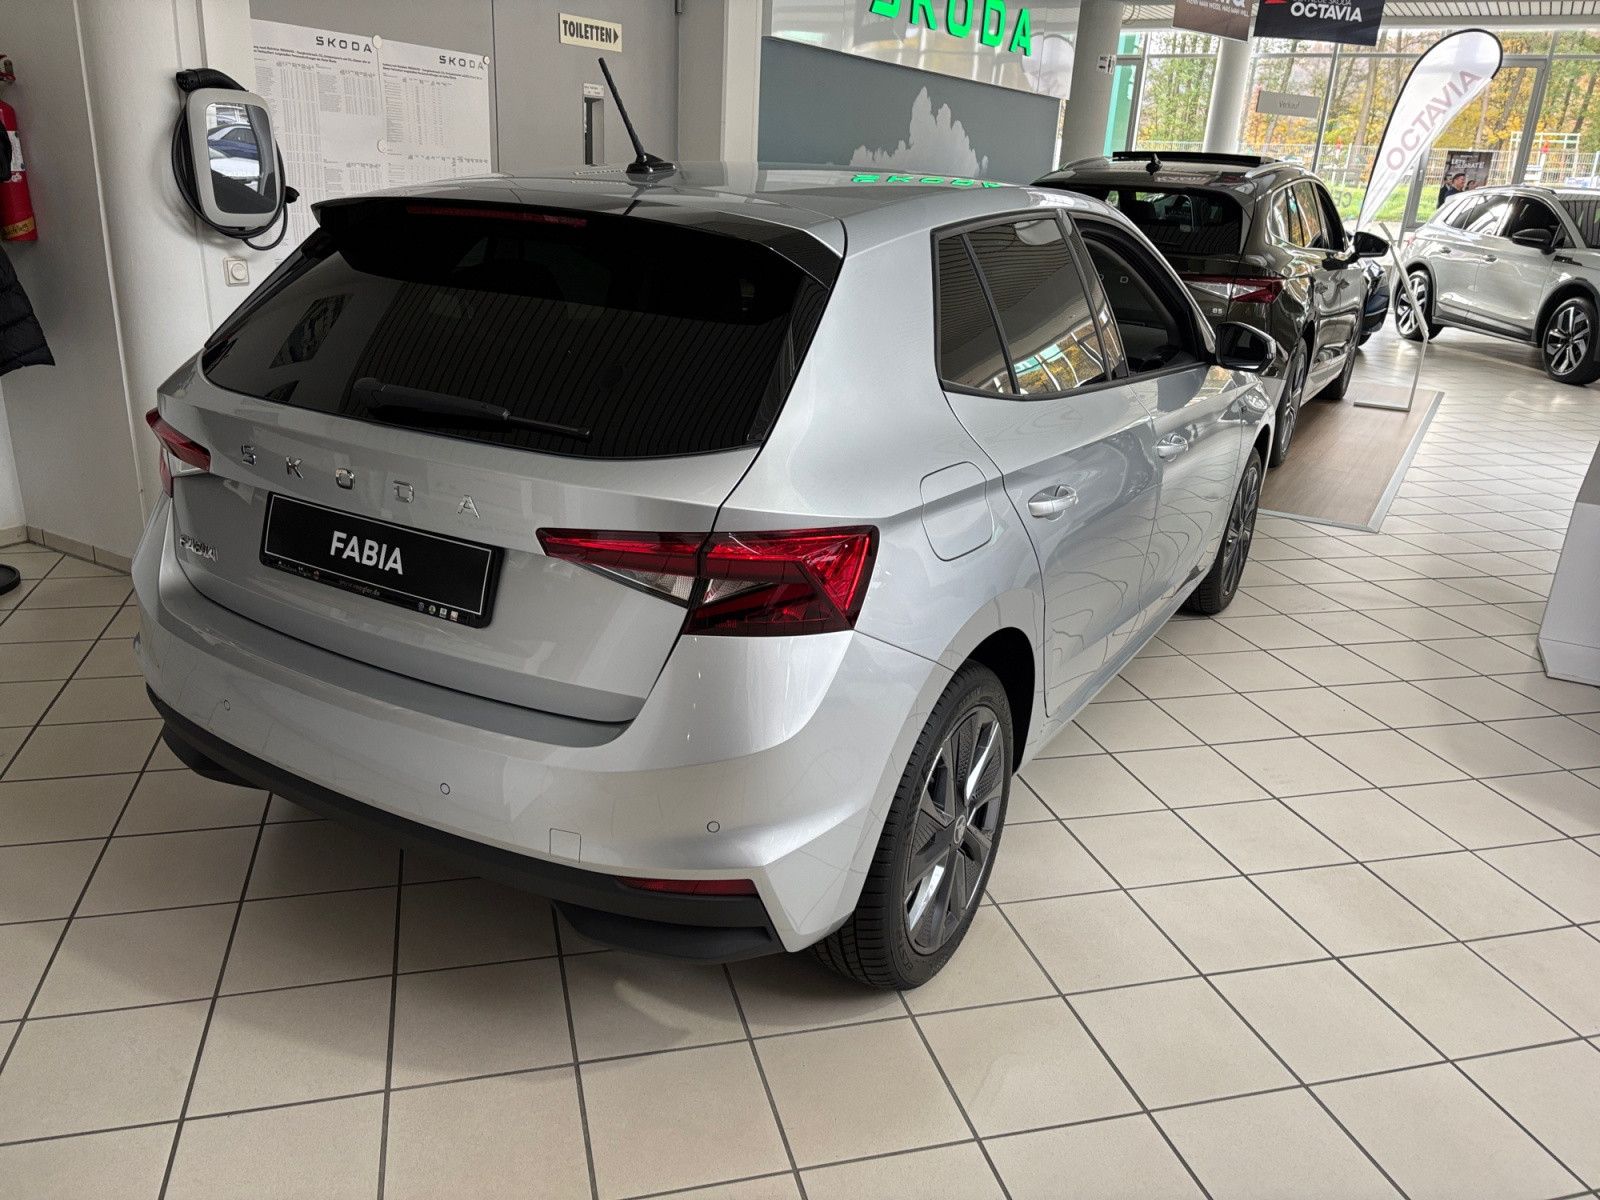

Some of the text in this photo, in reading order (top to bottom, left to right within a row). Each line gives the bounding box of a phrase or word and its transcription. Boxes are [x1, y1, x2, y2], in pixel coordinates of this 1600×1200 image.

[1290, 1, 1363, 22] OCTAVIA
[315, 36, 373, 53] SKODA
[562, 19, 612, 44] TOILETTEN
[1386, 70, 1483, 171] OCTAVIA
[241, 444, 480, 519] SKODA
[330, 530, 404, 575] FABIA
